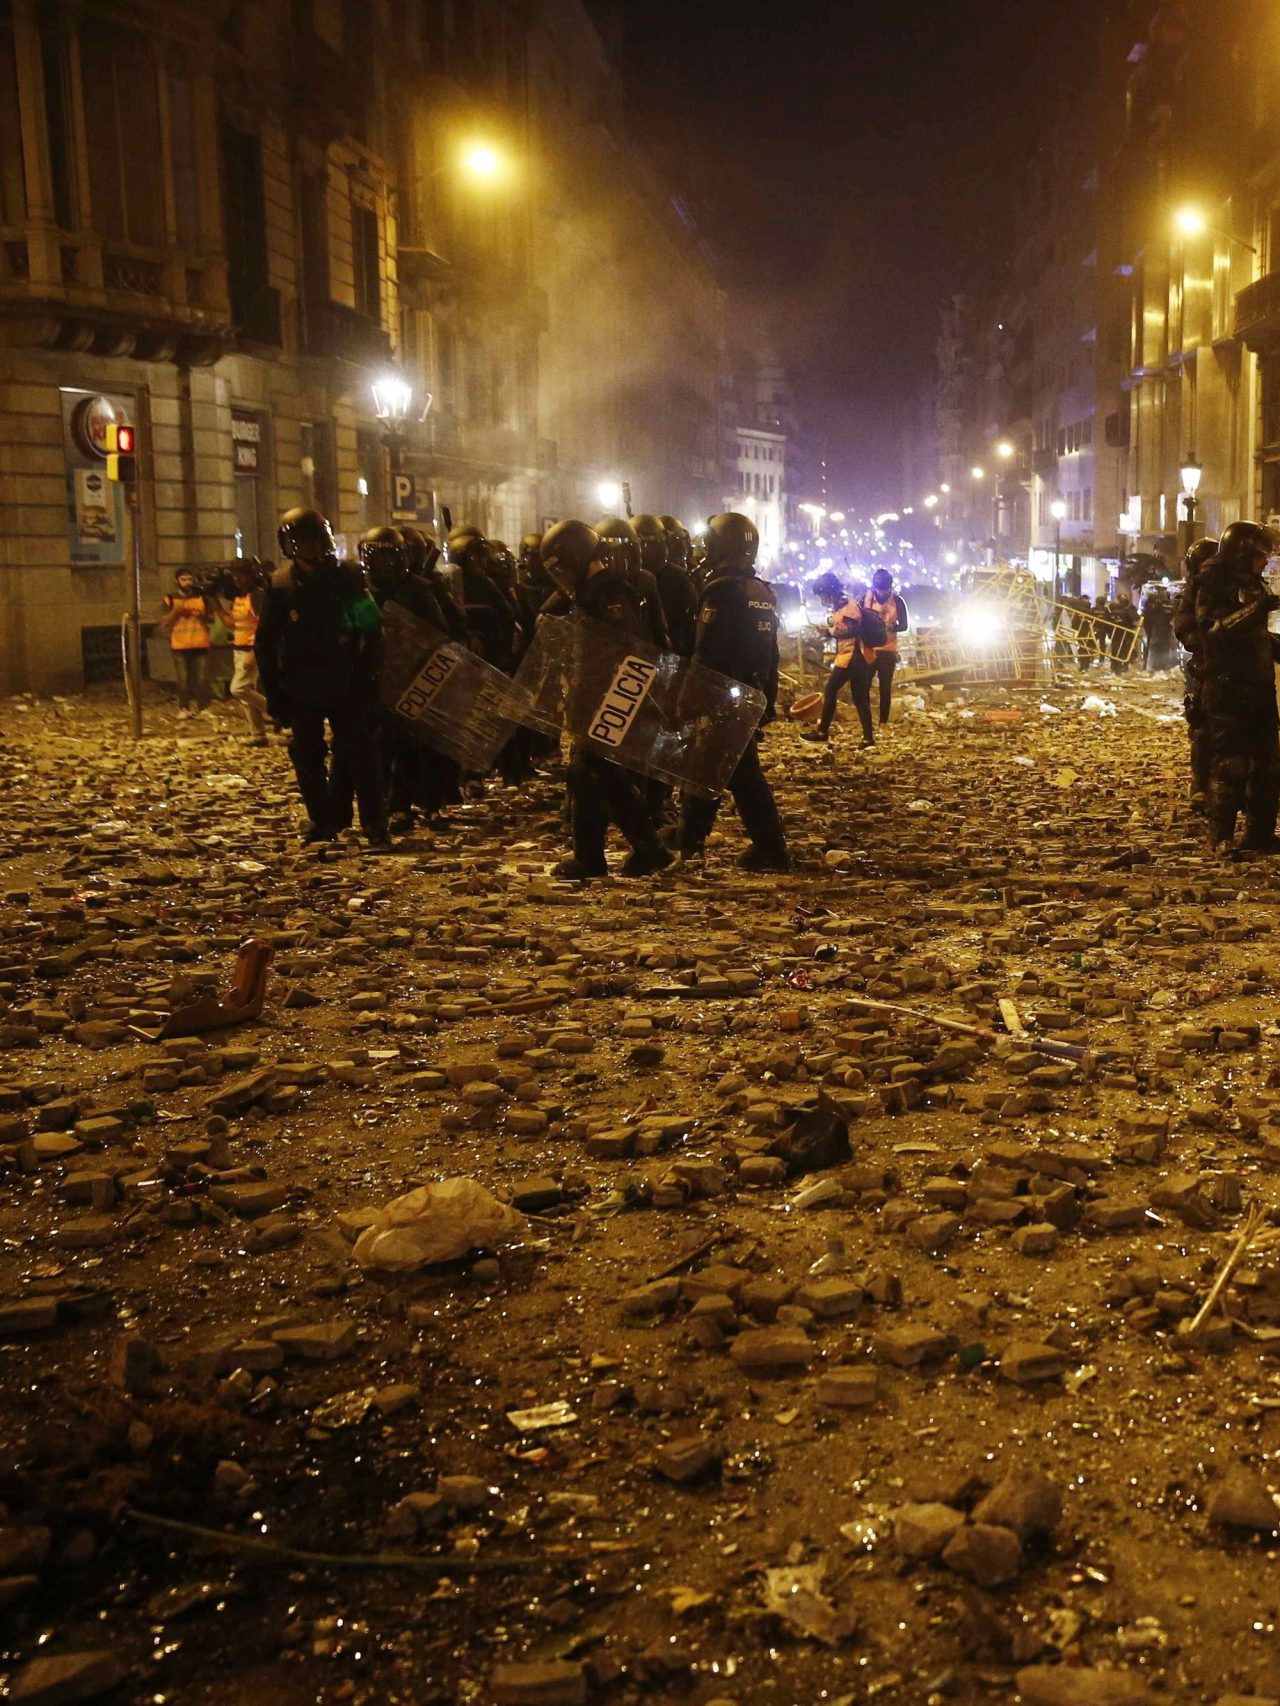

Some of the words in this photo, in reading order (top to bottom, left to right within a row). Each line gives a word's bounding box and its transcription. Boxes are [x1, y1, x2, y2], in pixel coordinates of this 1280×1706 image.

[395, 475, 411, 507] P
[398, 653, 457, 717] POLICIA
[591, 661, 655, 744] POLICIA
